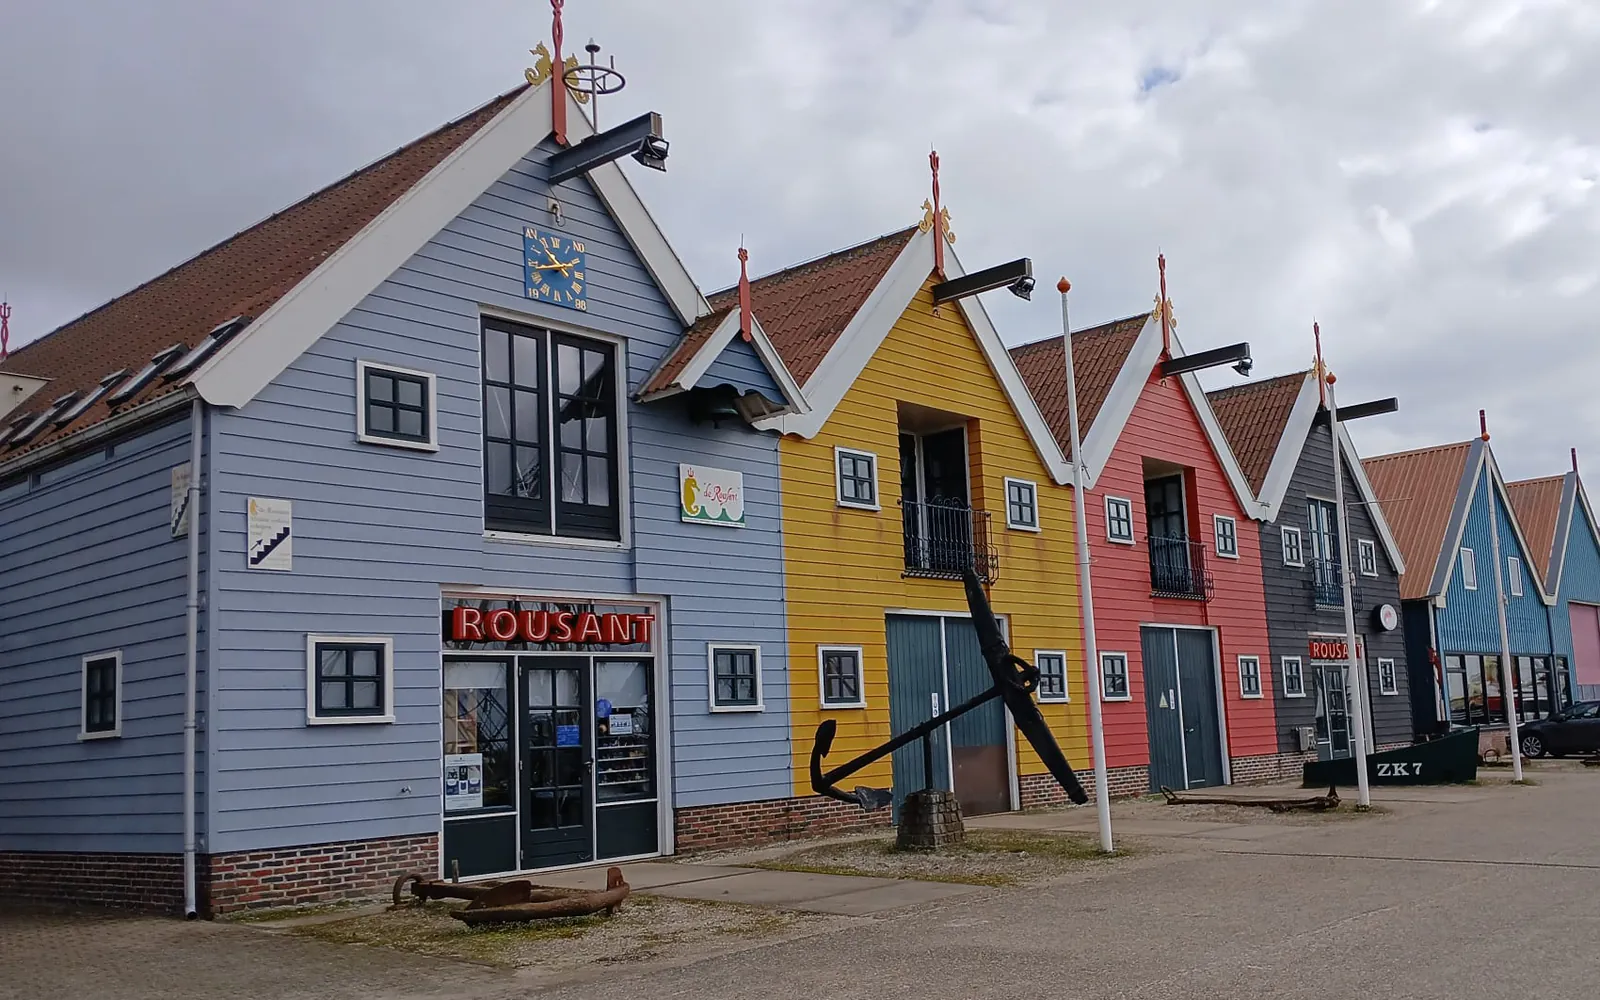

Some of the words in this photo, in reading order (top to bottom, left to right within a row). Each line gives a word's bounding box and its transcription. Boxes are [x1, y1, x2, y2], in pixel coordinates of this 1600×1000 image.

[453, 607, 655, 644] ROUSANT
[1312, 642, 1363, 659] ROUSAT
[1376, 762, 1410, 777] ZK
[1412, 762, 1423, 776] 7
